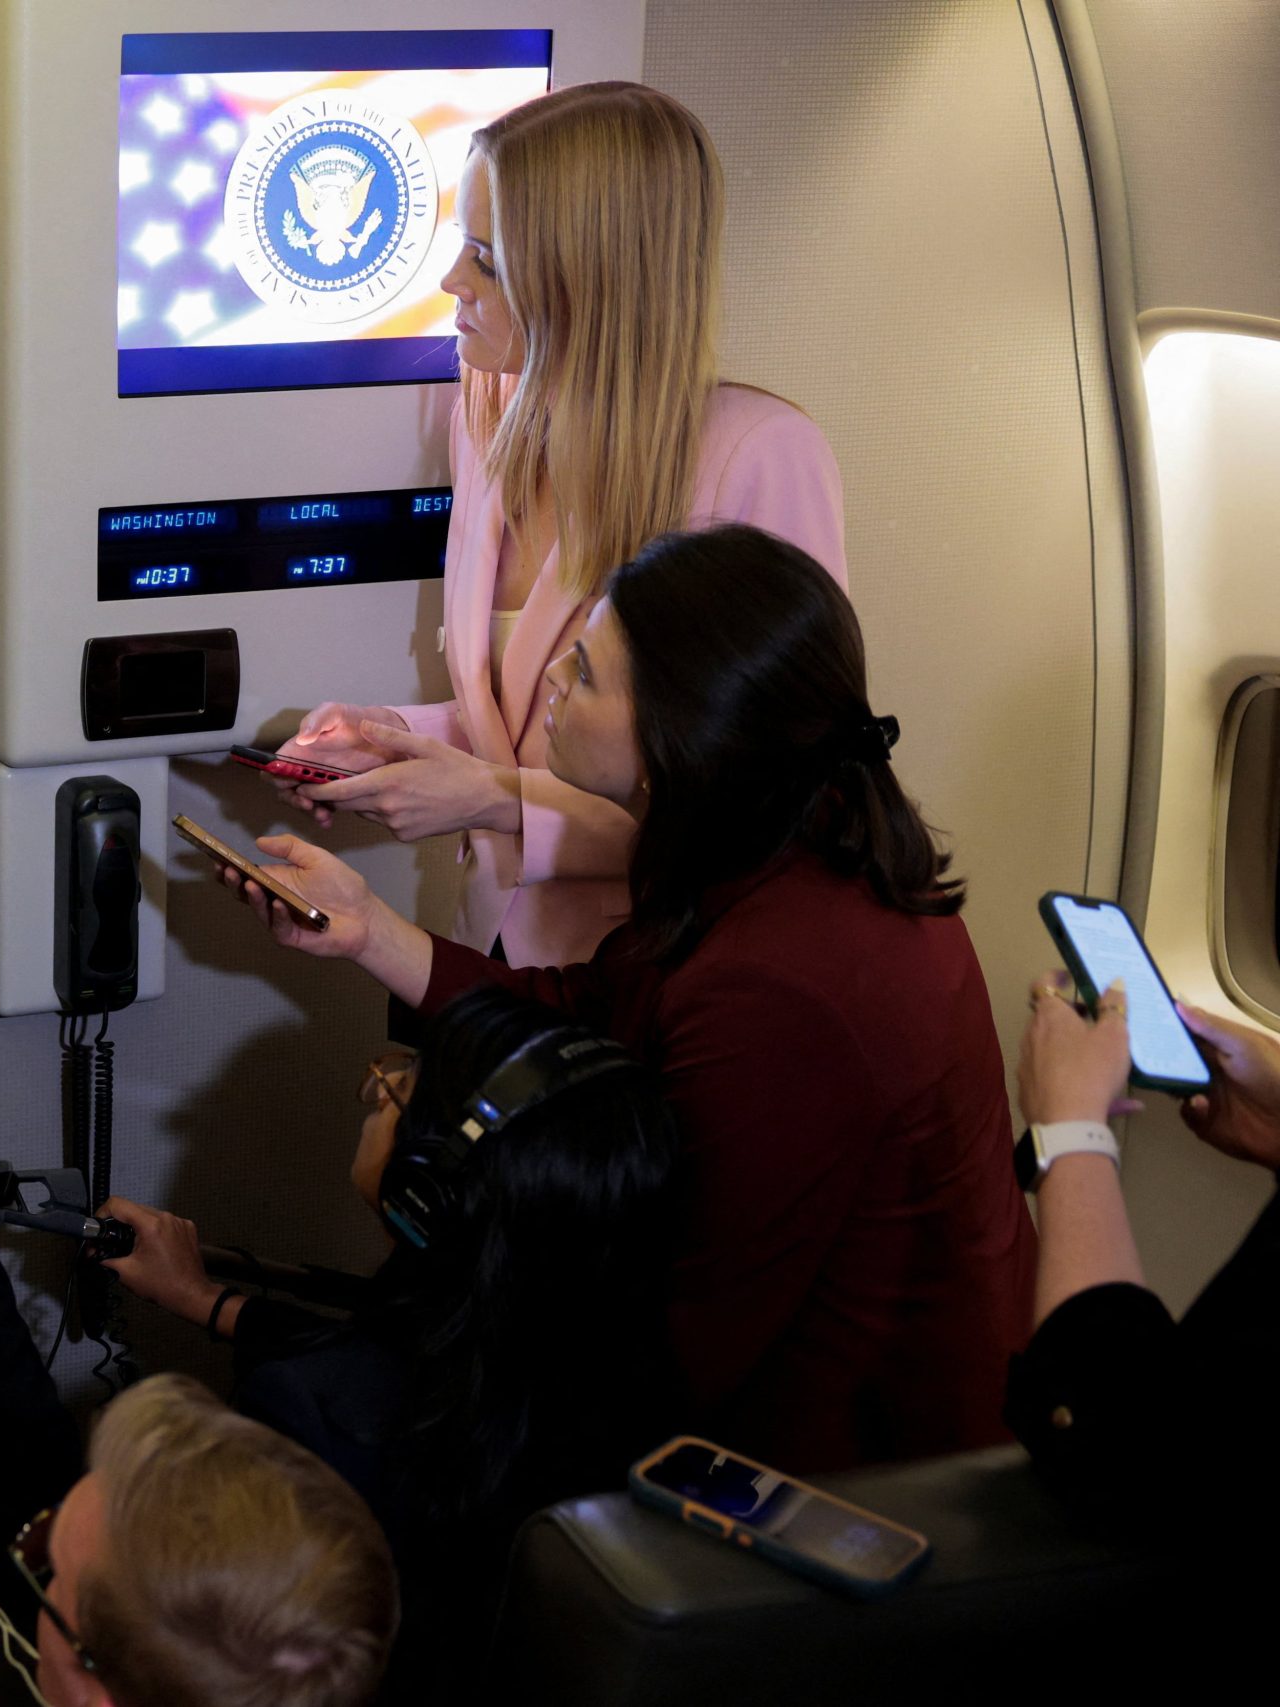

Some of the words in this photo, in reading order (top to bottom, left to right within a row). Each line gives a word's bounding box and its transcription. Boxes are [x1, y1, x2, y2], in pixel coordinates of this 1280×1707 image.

[289, 503, 341, 520] LOCAL
[413, 496, 452, 512] DEST
[111, 511, 217, 531] WASHINGTON
[309, 557, 345, 574] 7:37
[145, 567, 190, 585] 10:37
